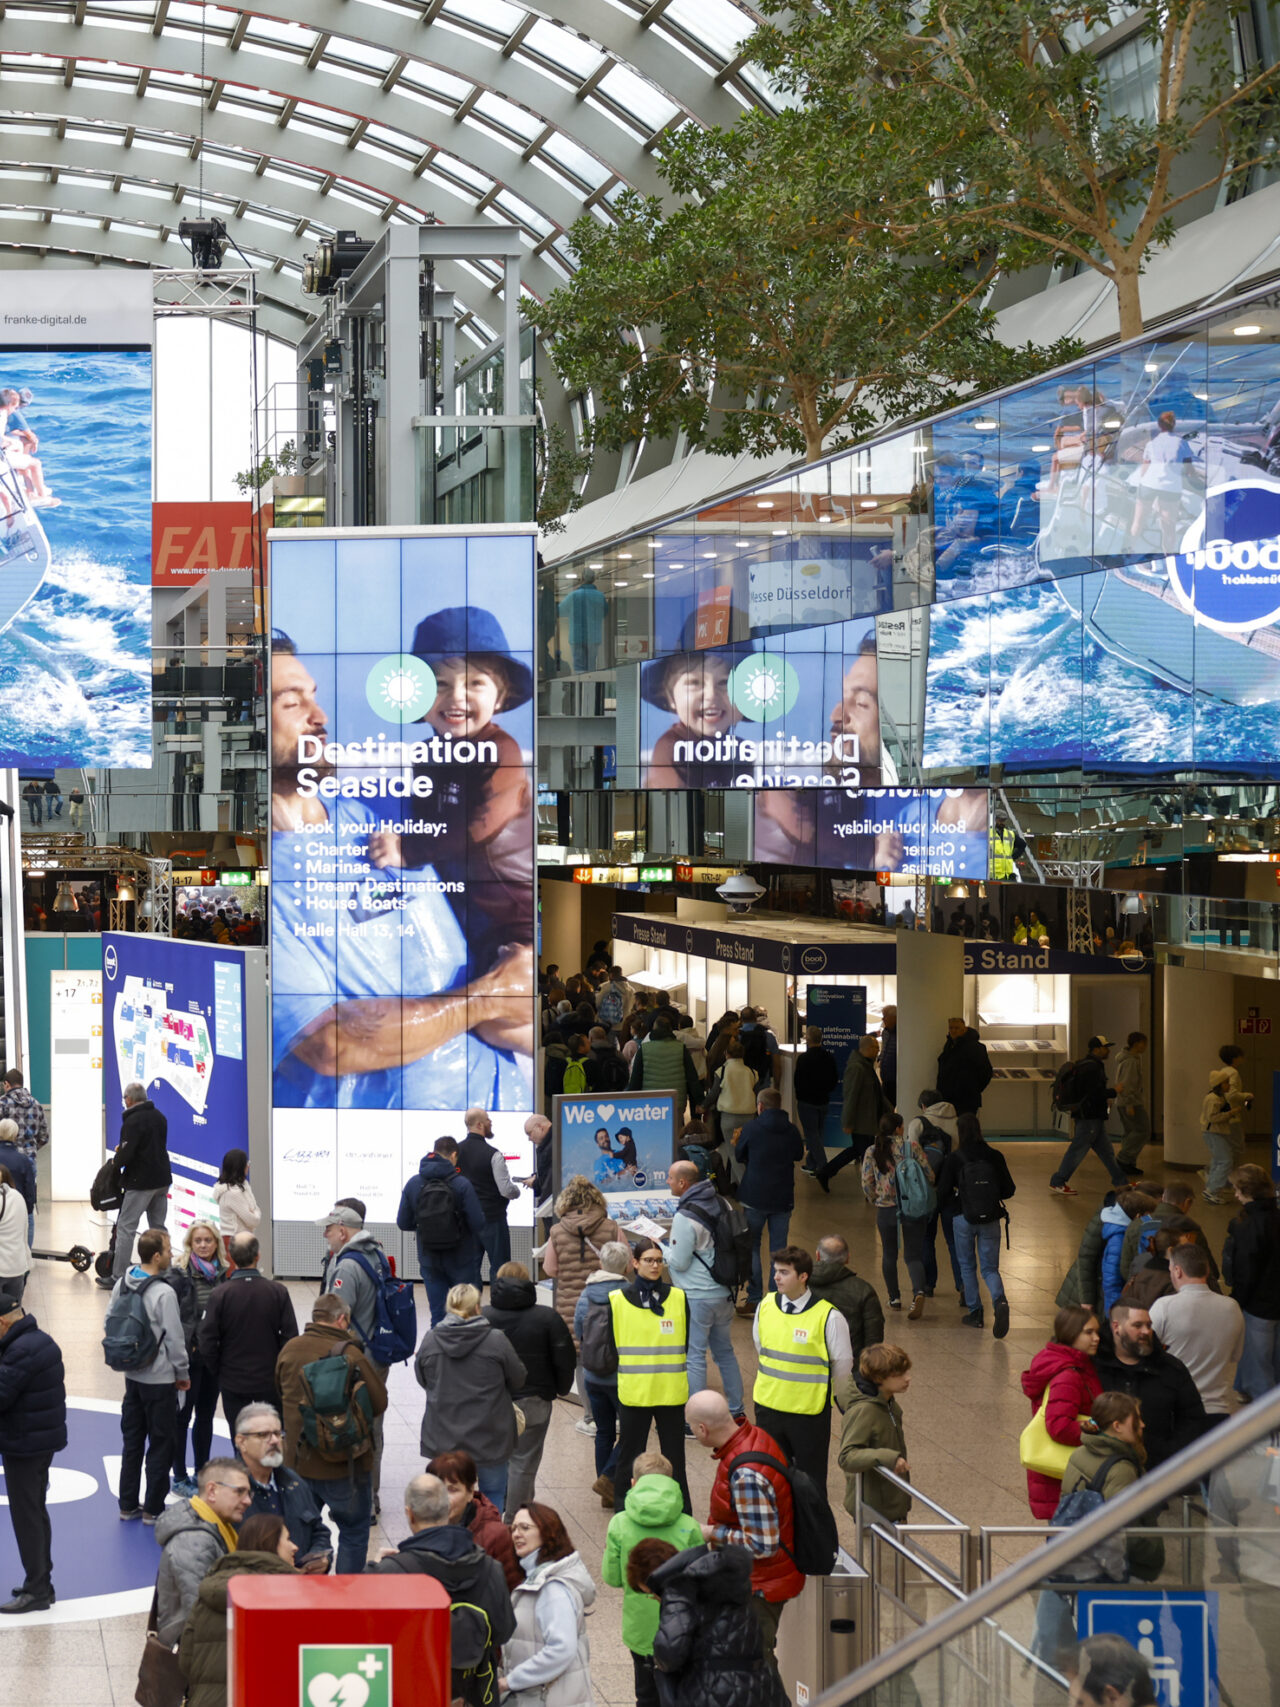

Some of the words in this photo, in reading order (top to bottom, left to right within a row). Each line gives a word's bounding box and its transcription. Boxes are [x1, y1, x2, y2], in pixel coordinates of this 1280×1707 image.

[4, 314, 87, 327] franke-digital.de
[776, 585, 852, 600] Düsseldorf
[297, 732, 498, 764] Destination
[296, 767, 434, 798] Seaside
[294, 820, 334, 834] Book
[340, 822, 376, 837] your
[381, 819, 448, 837] Holiday:
[306, 842, 369, 856] Charter
[306, 859, 371, 874] Marinas
[306, 877, 360, 892] Dream
[364, 877, 465, 893] Destinations
[306, 896, 358, 910] House
[362, 895, 407, 910] Boats
[294, 923, 334, 937] Halle
[338, 923, 367, 937] Hall
[372, 923, 393, 939] 13,
[396, 924, 415, 937] 14
[633, 923, 650, 942] Presse
[650, 927, 667, 946] Stand
[716, 938, 733, 958] Press
[734, 942, 755, 962] Stand
[805, 955, 823, 963] boot
[981, 949, 1050, 969] Stand
[65, 988, 77, 998] 17
[564, 1104, 595, 1124] We
[618, 1103, 669, 1122] water
